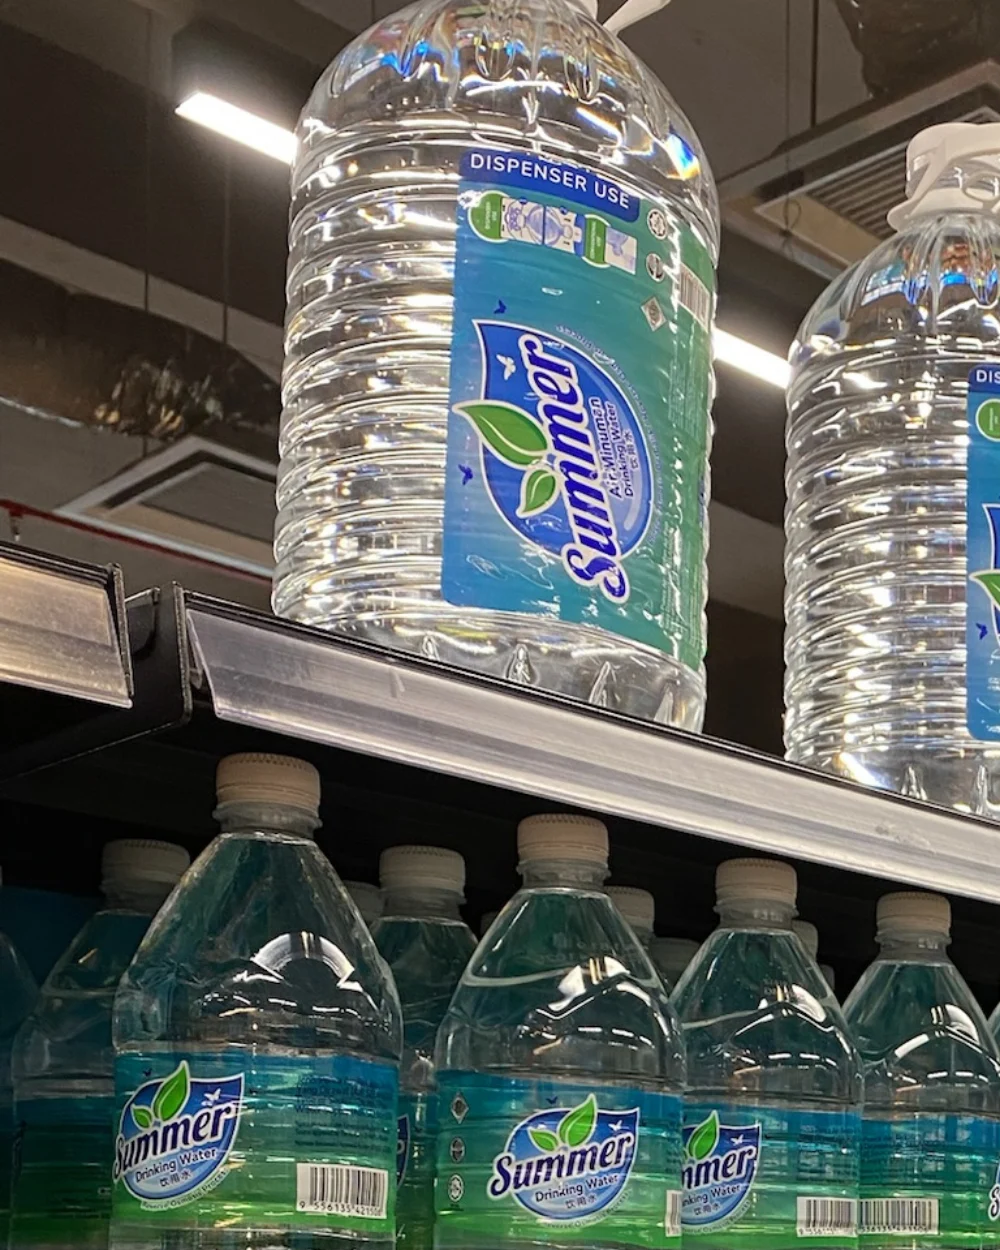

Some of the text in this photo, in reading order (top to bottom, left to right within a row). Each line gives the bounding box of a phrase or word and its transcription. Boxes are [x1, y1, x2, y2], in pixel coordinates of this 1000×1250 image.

[470, 153, 630, 209] DISPENSER USE
[522, 336, 627, 600] Summer
[589, 397, 623, 499] Air Minuman
[605, 402, 634, 498] Drinking Water
[114, 1104, 232, 1179] Summer
[135, 1147, 217, 1183] Drinking Water
[489, 1134, 632, 1197] Summer
[299, 1200, 306, 1209] 9
[535, 1173, 619, 1203] Drinking Water
[710, 1184, 741, 1199] Water
